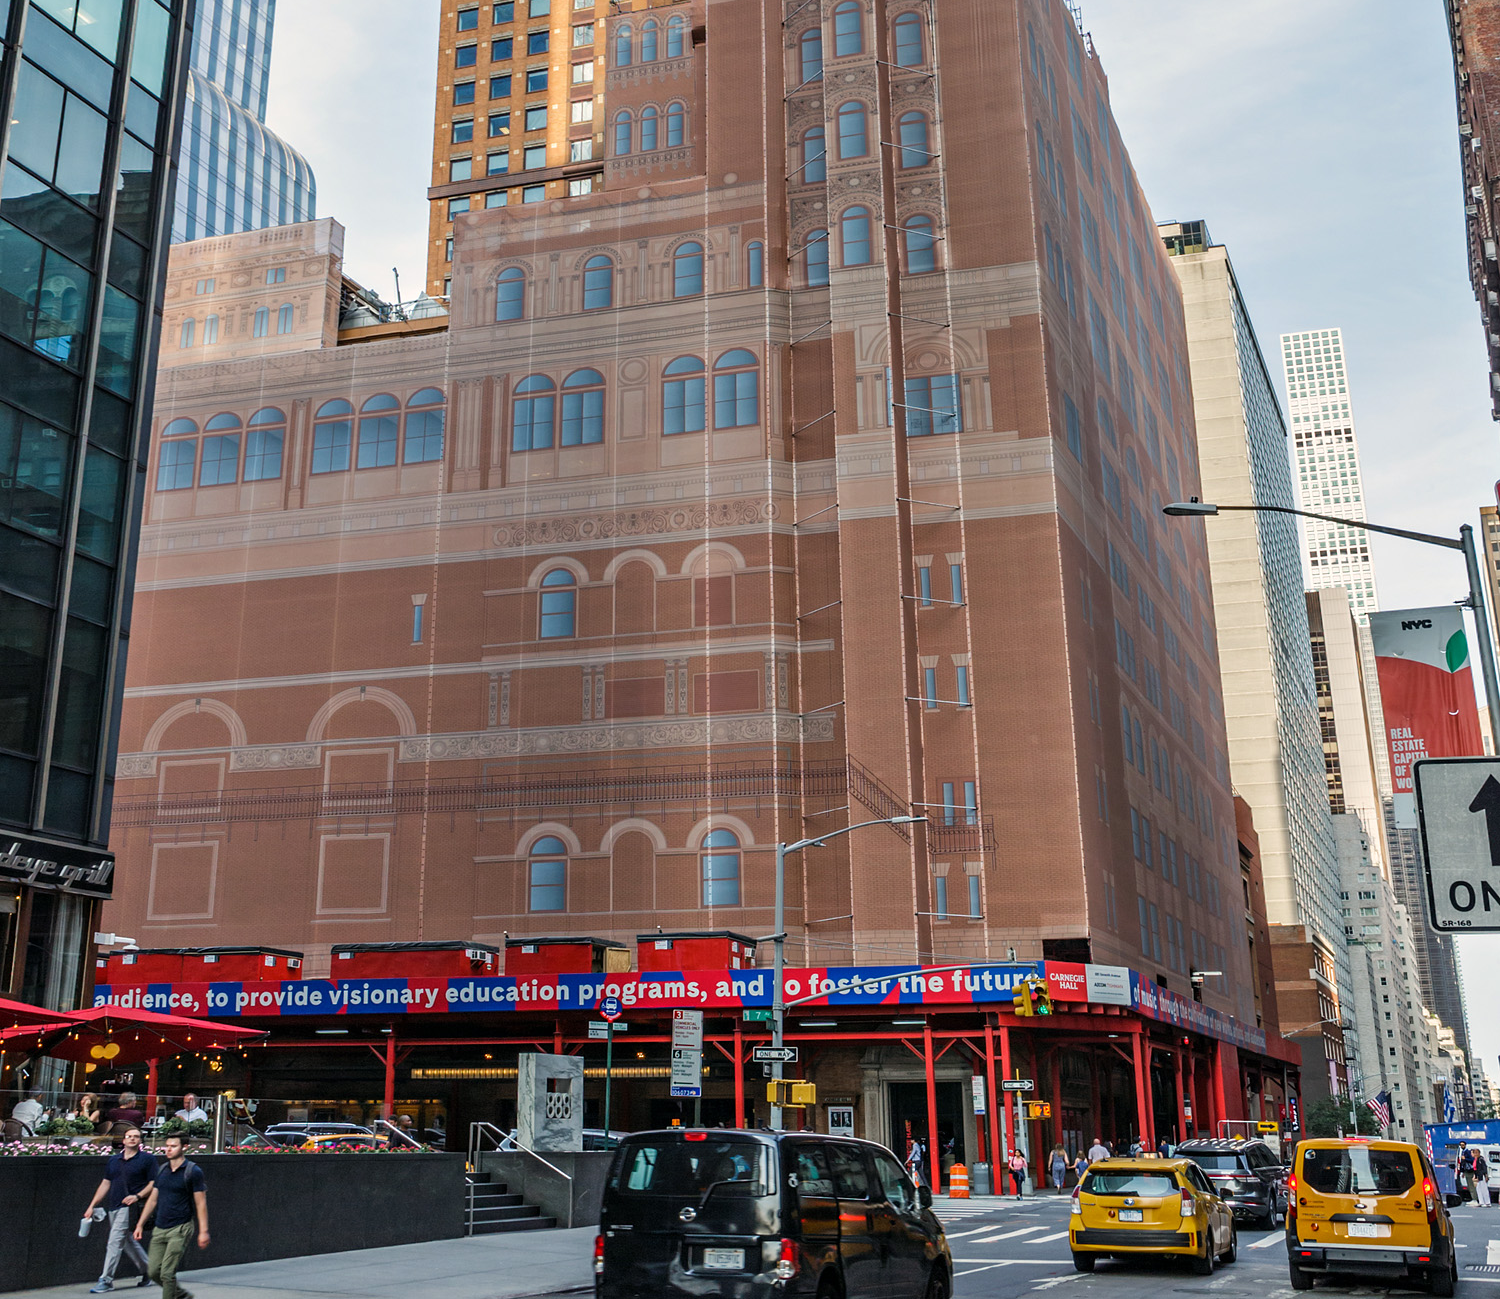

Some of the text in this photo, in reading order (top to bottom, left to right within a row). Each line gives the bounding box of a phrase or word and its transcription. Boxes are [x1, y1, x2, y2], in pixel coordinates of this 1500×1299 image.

[1401, 619, 1432, 630] NYC
[1390, 727, 1414, 740] REAL
[1391, 738, 1425, 752] ESTATE
[1395, 765, 1407, 777] OF
[59, 860, 113, 887] grill
[1049, 972, 1085, 983] CARNEGIE
[1059, 981, 1079, 990] HALL
[94, 987, 199, 1012] audience,
[206, 988, 228, 1007] to
[236, 985, 322, 1012] provide
[328, 983, 439, 1008] visionary
[445, 979, 569, 1003] education
[578, 980, 707, 1005] programs,
[715, 974, 764, 997] and
[808, 973, 891, 995] foster
[898, 972, 944, 993] the
[1133, 983, 1140, 1003] of
[1141, 988, 1158, 1011] music
[676, 1011, 682, 1019] 3
[755, 1011, 761, 1020] 7
[674, 1050, 681, 1058] 6
